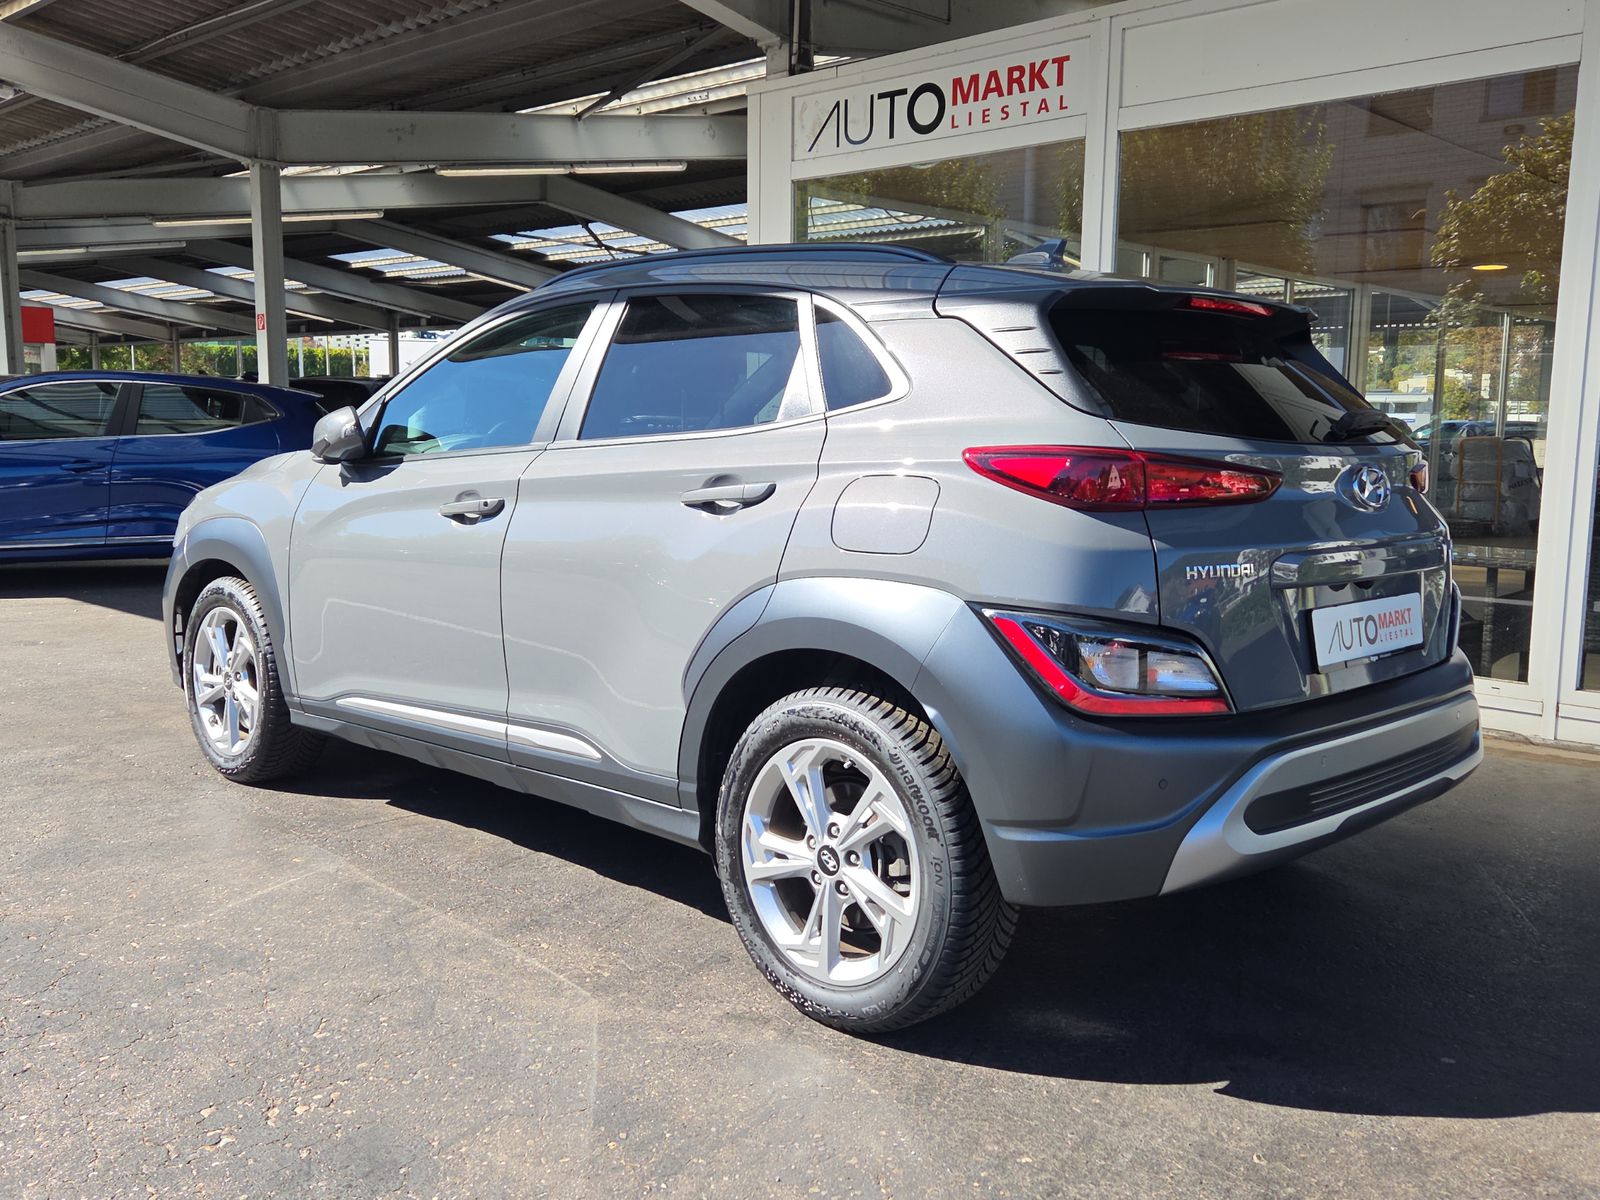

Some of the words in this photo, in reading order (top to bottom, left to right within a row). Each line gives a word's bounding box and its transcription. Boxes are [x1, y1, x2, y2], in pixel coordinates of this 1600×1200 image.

[951, 55, 1071, 107] MARKT
[951, 95, 1069, 129] LIESTAL
[1186, 563, 1254, 580] HYUNDAI
[1378, 607, 1412, 629] MARKT
[1379, 630, 1414, 643] LIESTAL
